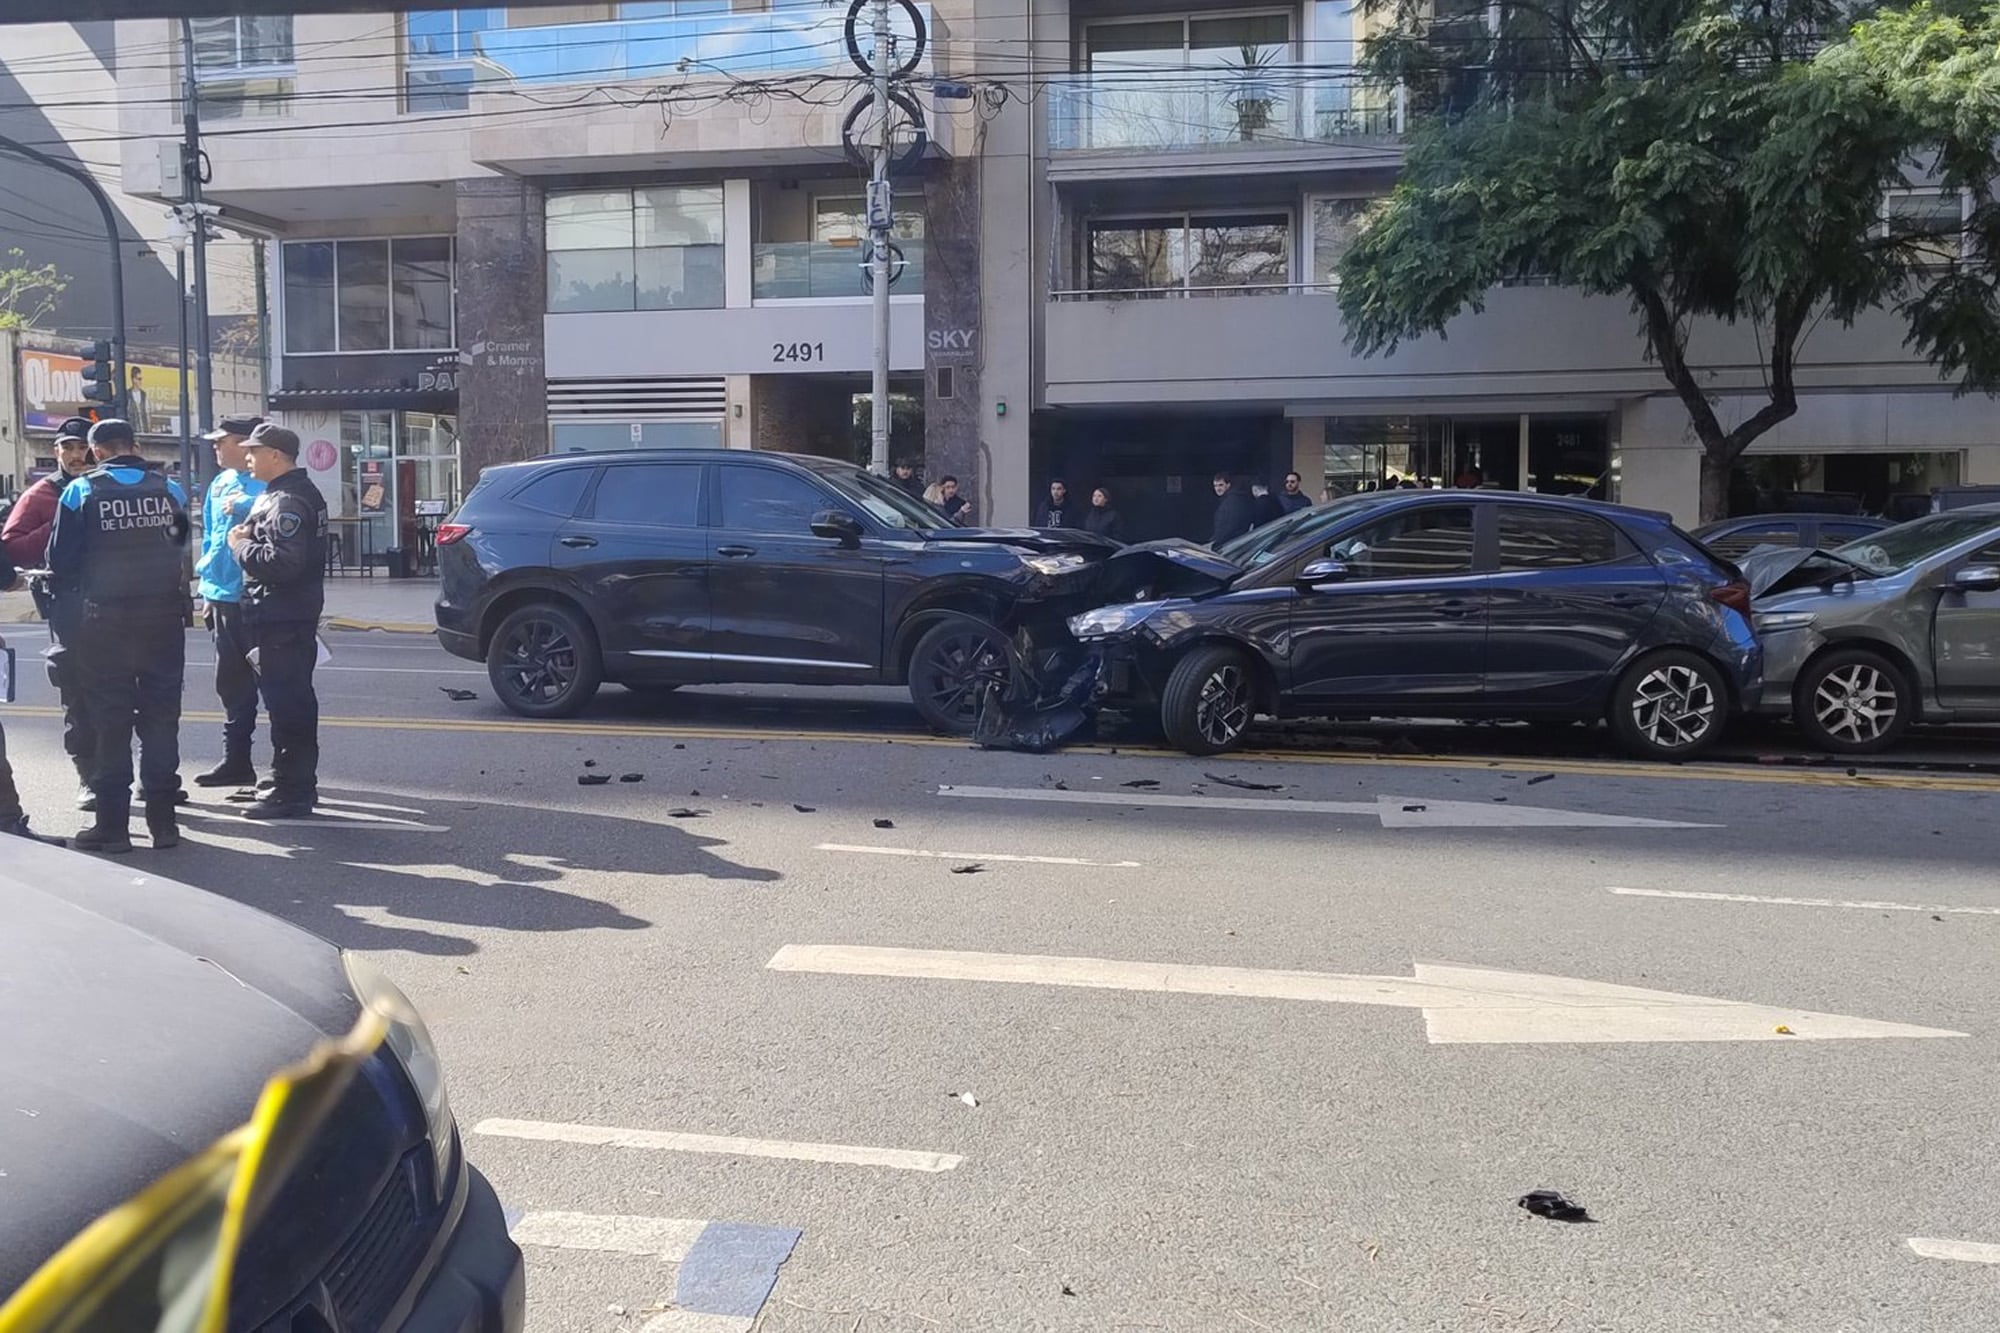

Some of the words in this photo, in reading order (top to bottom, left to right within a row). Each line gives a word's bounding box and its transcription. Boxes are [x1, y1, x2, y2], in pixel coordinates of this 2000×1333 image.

[487, 341, 531, 352] Cramer
[928, 329, 976, 349] SKY
[487, 355, 498, 366] &
[773, 342, 824, 362] 2491
[99, 497, 173, 518] POLICIA
[101, 519, 116, 531] DE
[118, 518, 135, 530] LA
[136, 515, 174, 528] CIUDAD
